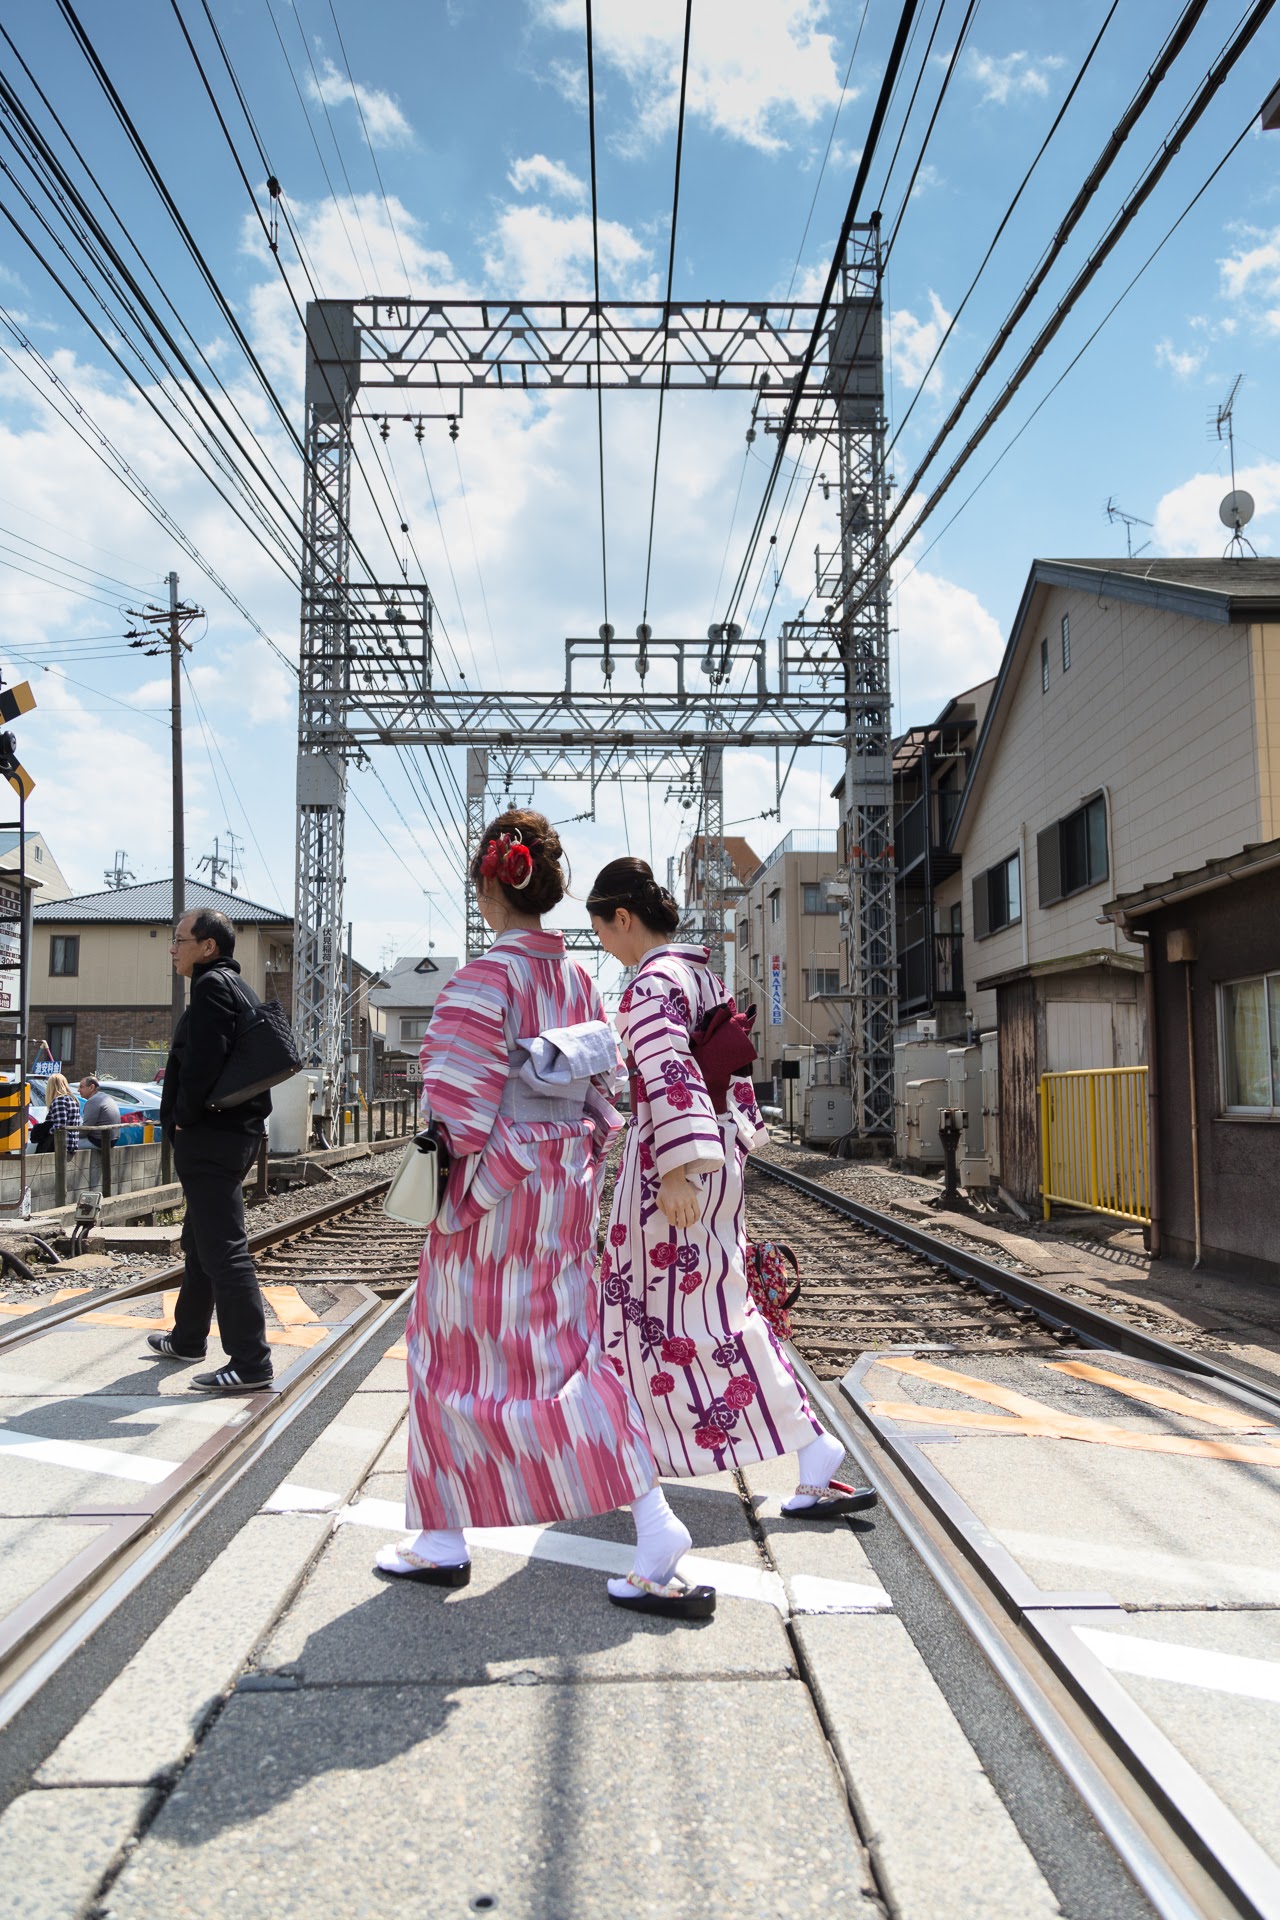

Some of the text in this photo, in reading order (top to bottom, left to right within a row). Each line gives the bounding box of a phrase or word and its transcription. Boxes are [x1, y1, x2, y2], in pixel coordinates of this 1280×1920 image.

[322, 927, 332, 962] 伏見稲荷
[772, 971, 781, 1024] WATANABE
[828, 1101, 835, 1109] B
